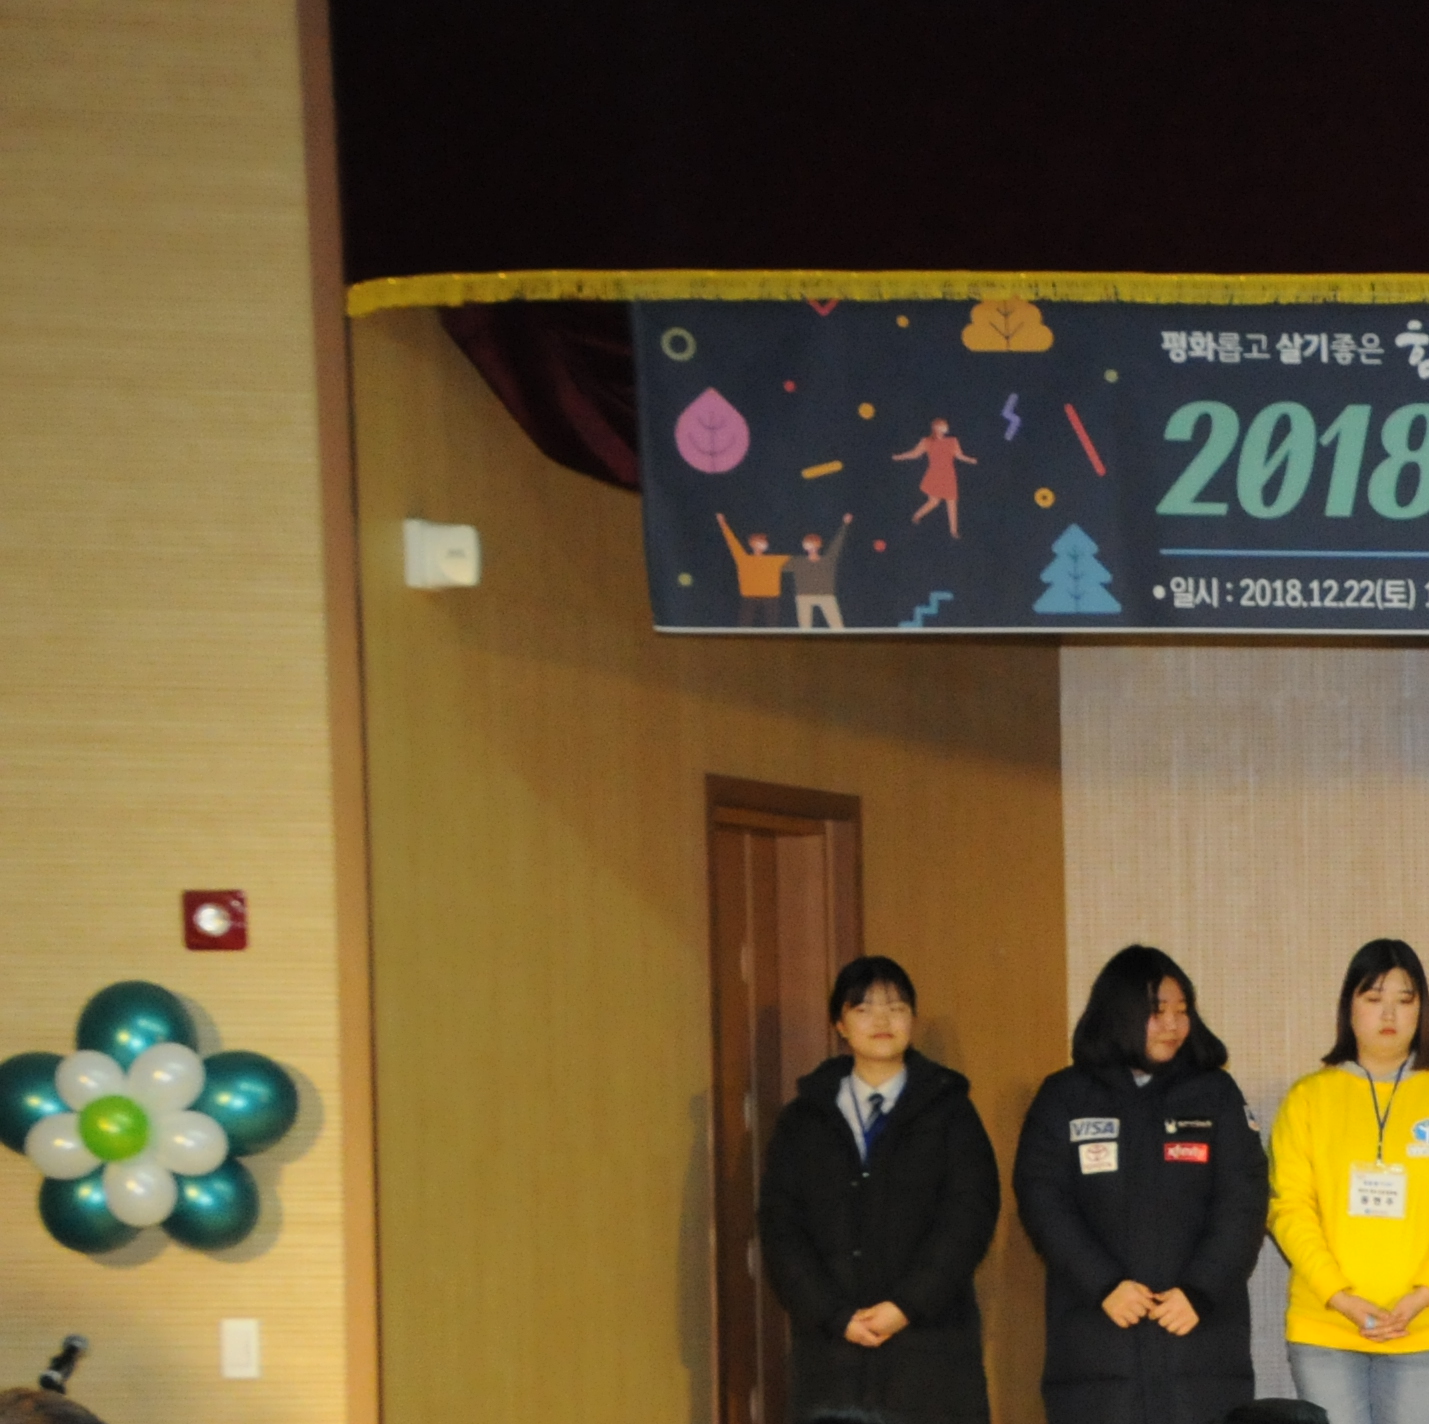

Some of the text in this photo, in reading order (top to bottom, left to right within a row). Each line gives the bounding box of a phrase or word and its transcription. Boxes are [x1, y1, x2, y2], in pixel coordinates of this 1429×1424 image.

[1161, 330, 1270, 363] 평화롭고
[1275, 331, 1385, 364] 살기좋은
[1169, 577, 1219, 609] 일시
[1239, 578, 1416, 610] 2018.12.22(토)
[1072, 1121, 1115, 1137] VISA
